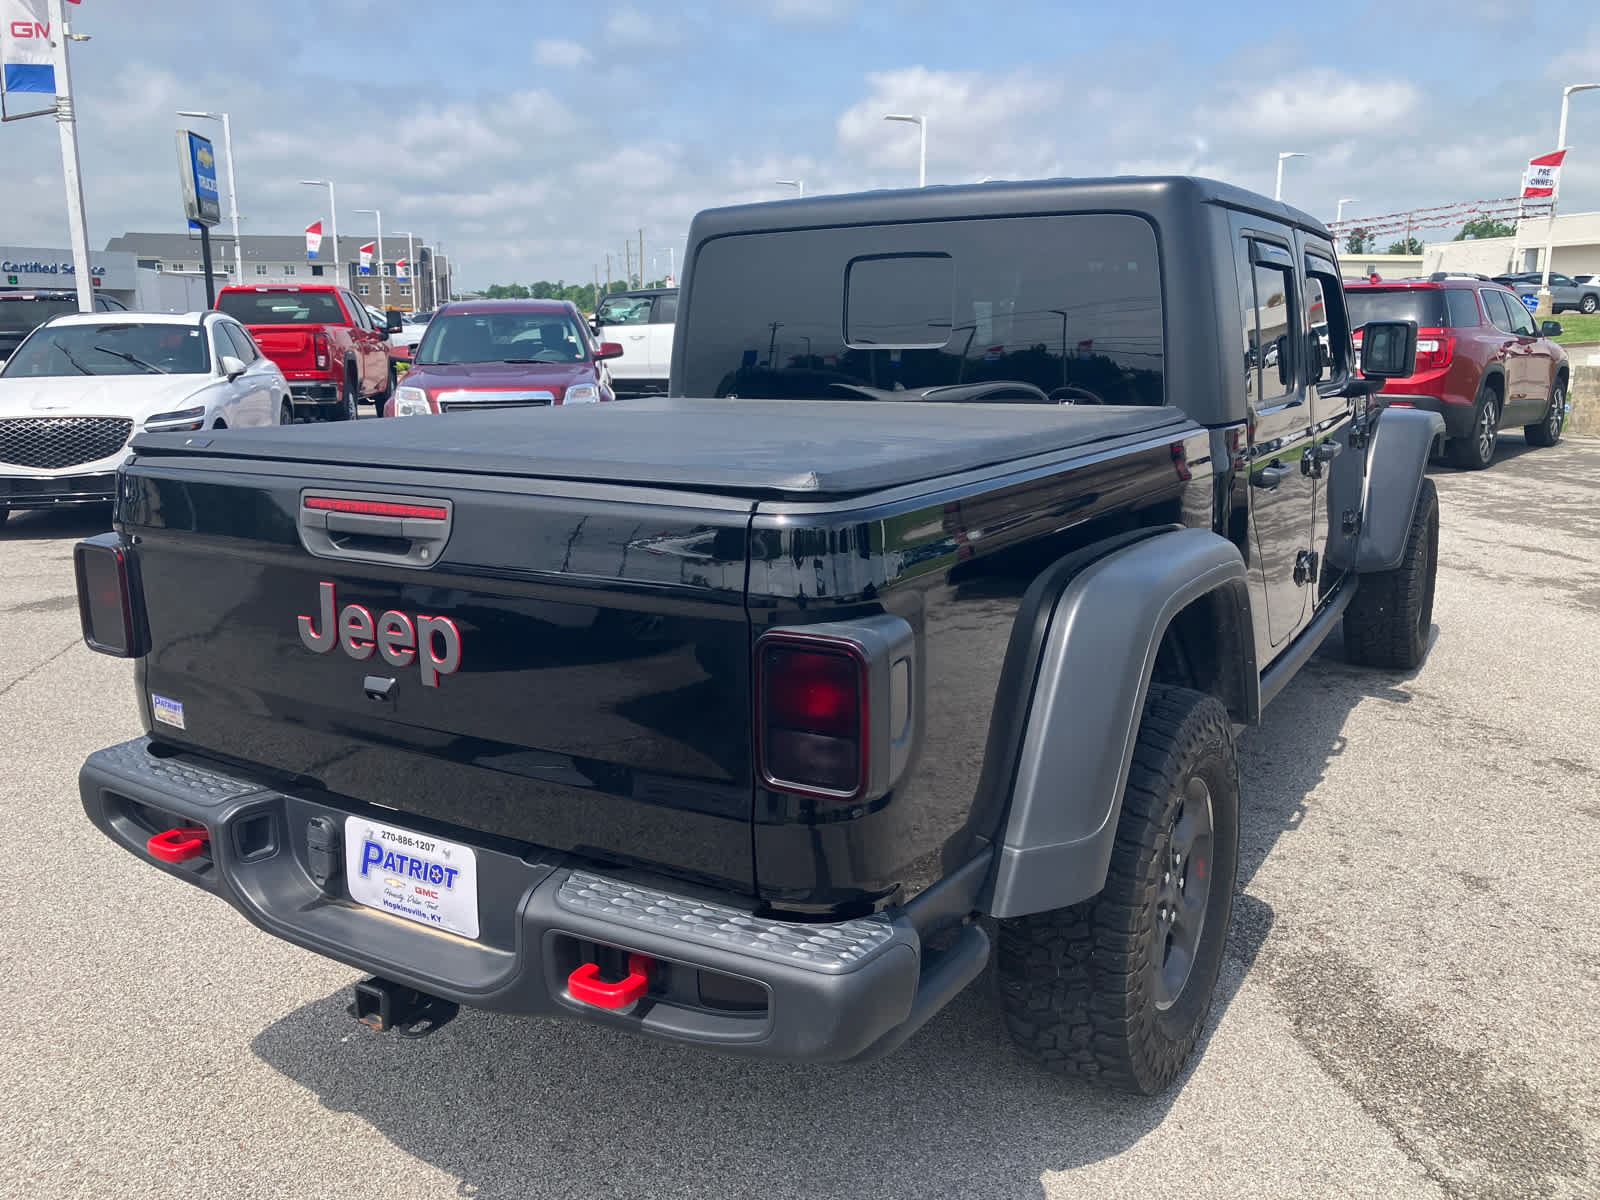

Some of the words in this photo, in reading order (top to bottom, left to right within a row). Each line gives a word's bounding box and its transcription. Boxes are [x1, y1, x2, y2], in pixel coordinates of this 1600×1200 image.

[11, 21, 50, 39] GM
[1538, 168, 1551, 176] PRE
[1530, 178, 1553, 186] OWNED
[2, 261, 58, 274] Certified
[62, 263, 105, 276] Sece
[297, 581, 461, 688] Jeep
[381, 830, 436, 852] 270-886-1207
[361, 841, 459, 888] PATRIOT
[414, 886, 439, 899] GMC
[383, 898, 429, 920] Hopkinsville,
[430, 913, 442, 923] KY
